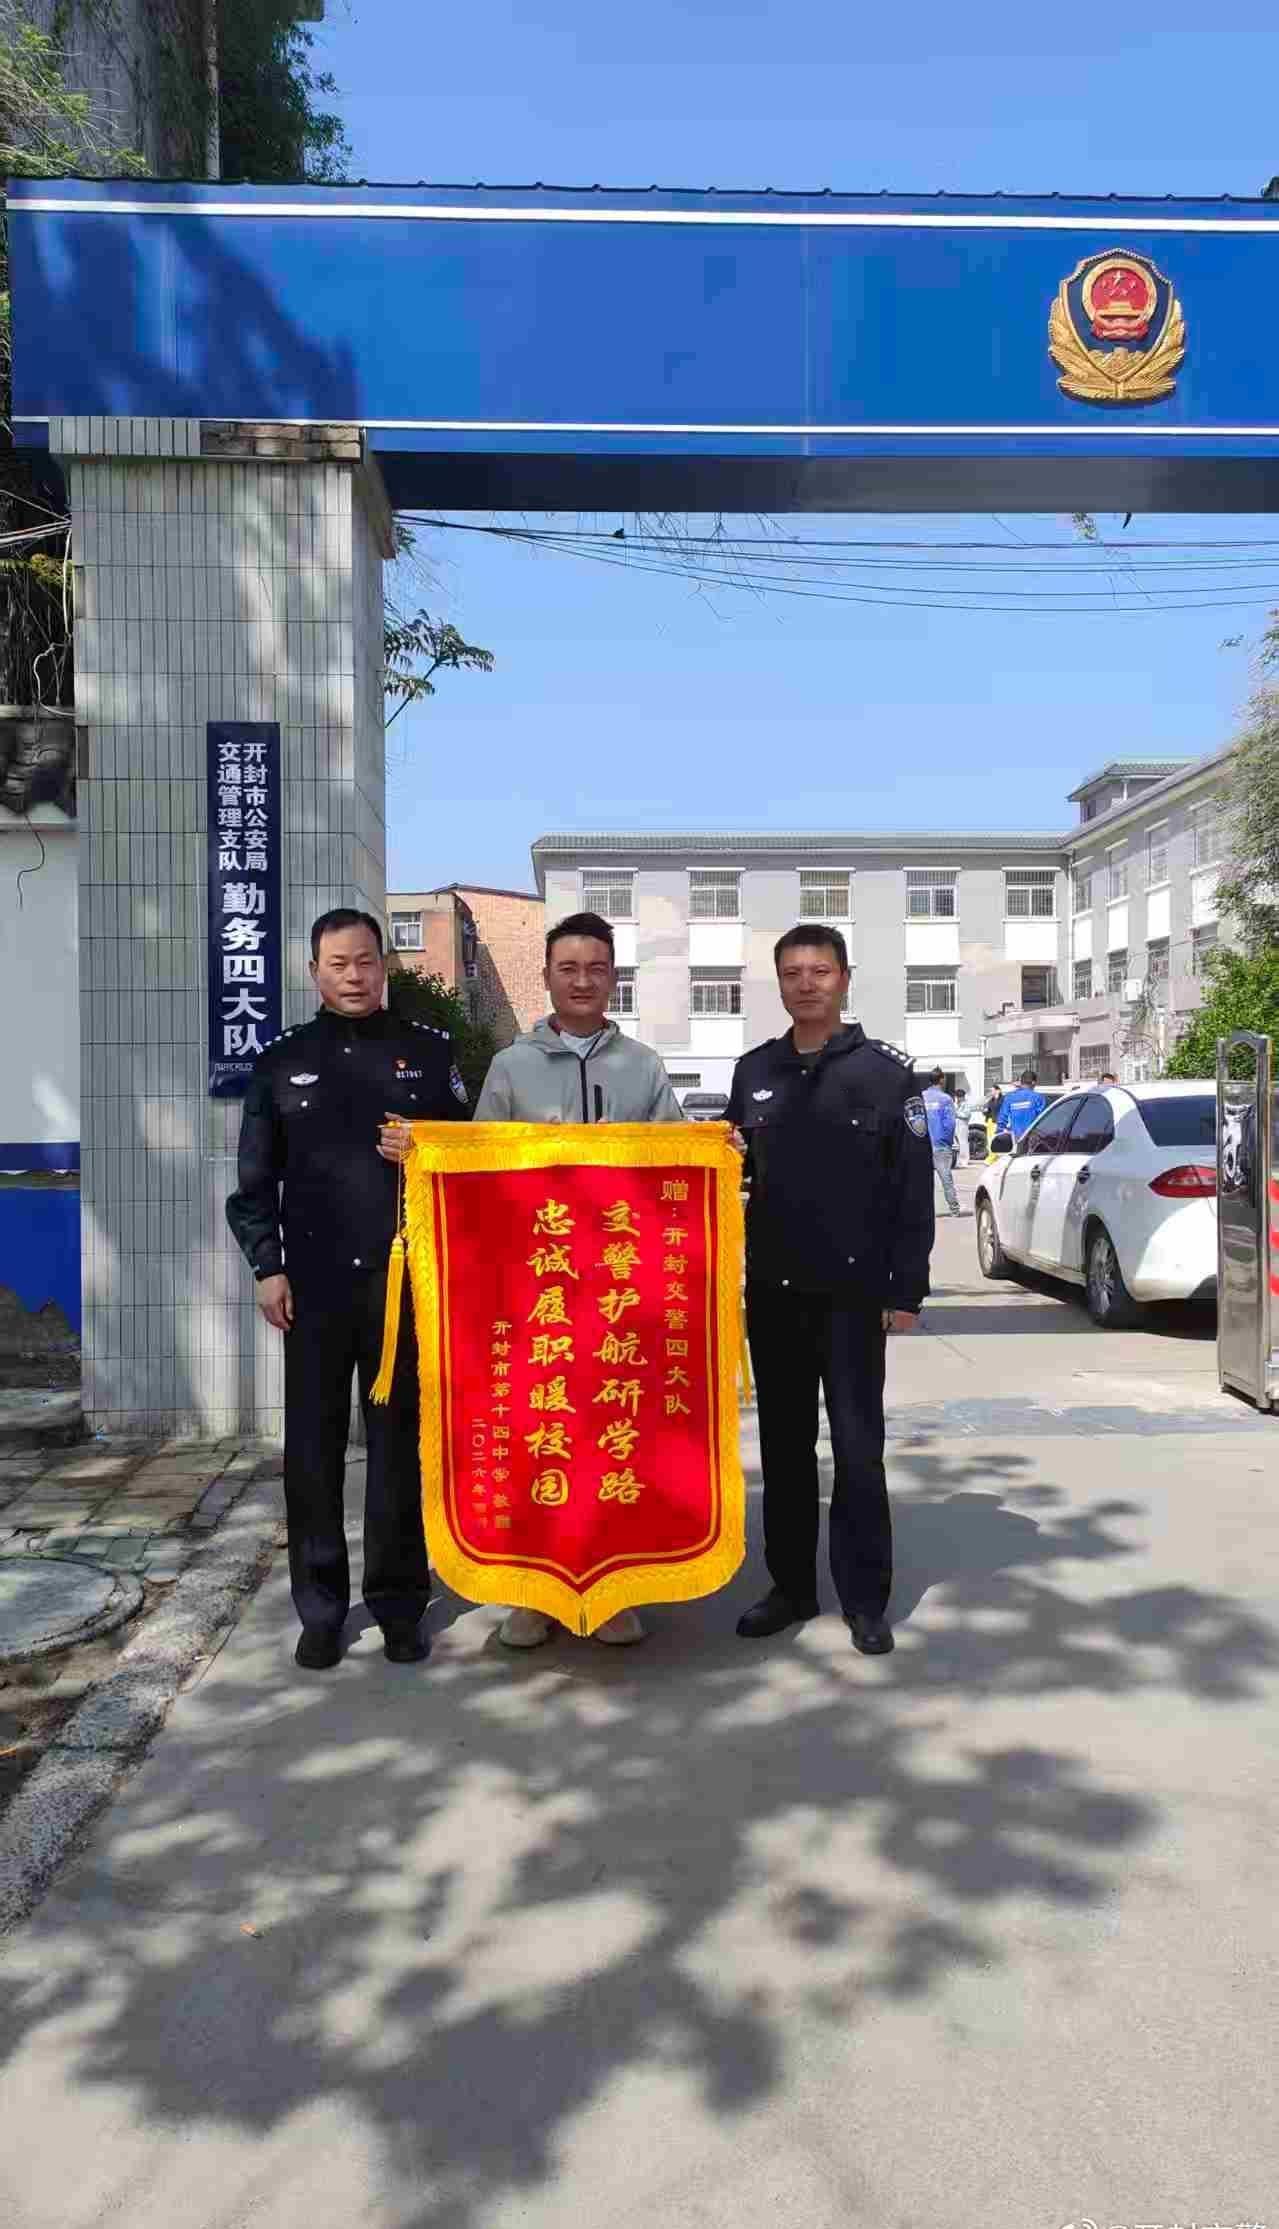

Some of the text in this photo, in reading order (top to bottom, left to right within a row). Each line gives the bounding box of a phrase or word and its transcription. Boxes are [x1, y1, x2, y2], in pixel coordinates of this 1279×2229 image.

[217, 741, 242, 871] 交通管理支队
[243, 742, 268, 871] 开封市公安局
[221, 882, 267, 1057] 勤务四大队
[524, 1198, 580, 1506] 忠诚履职暖校园
[592, 1200, 648, 1504] 交警护航研学路
